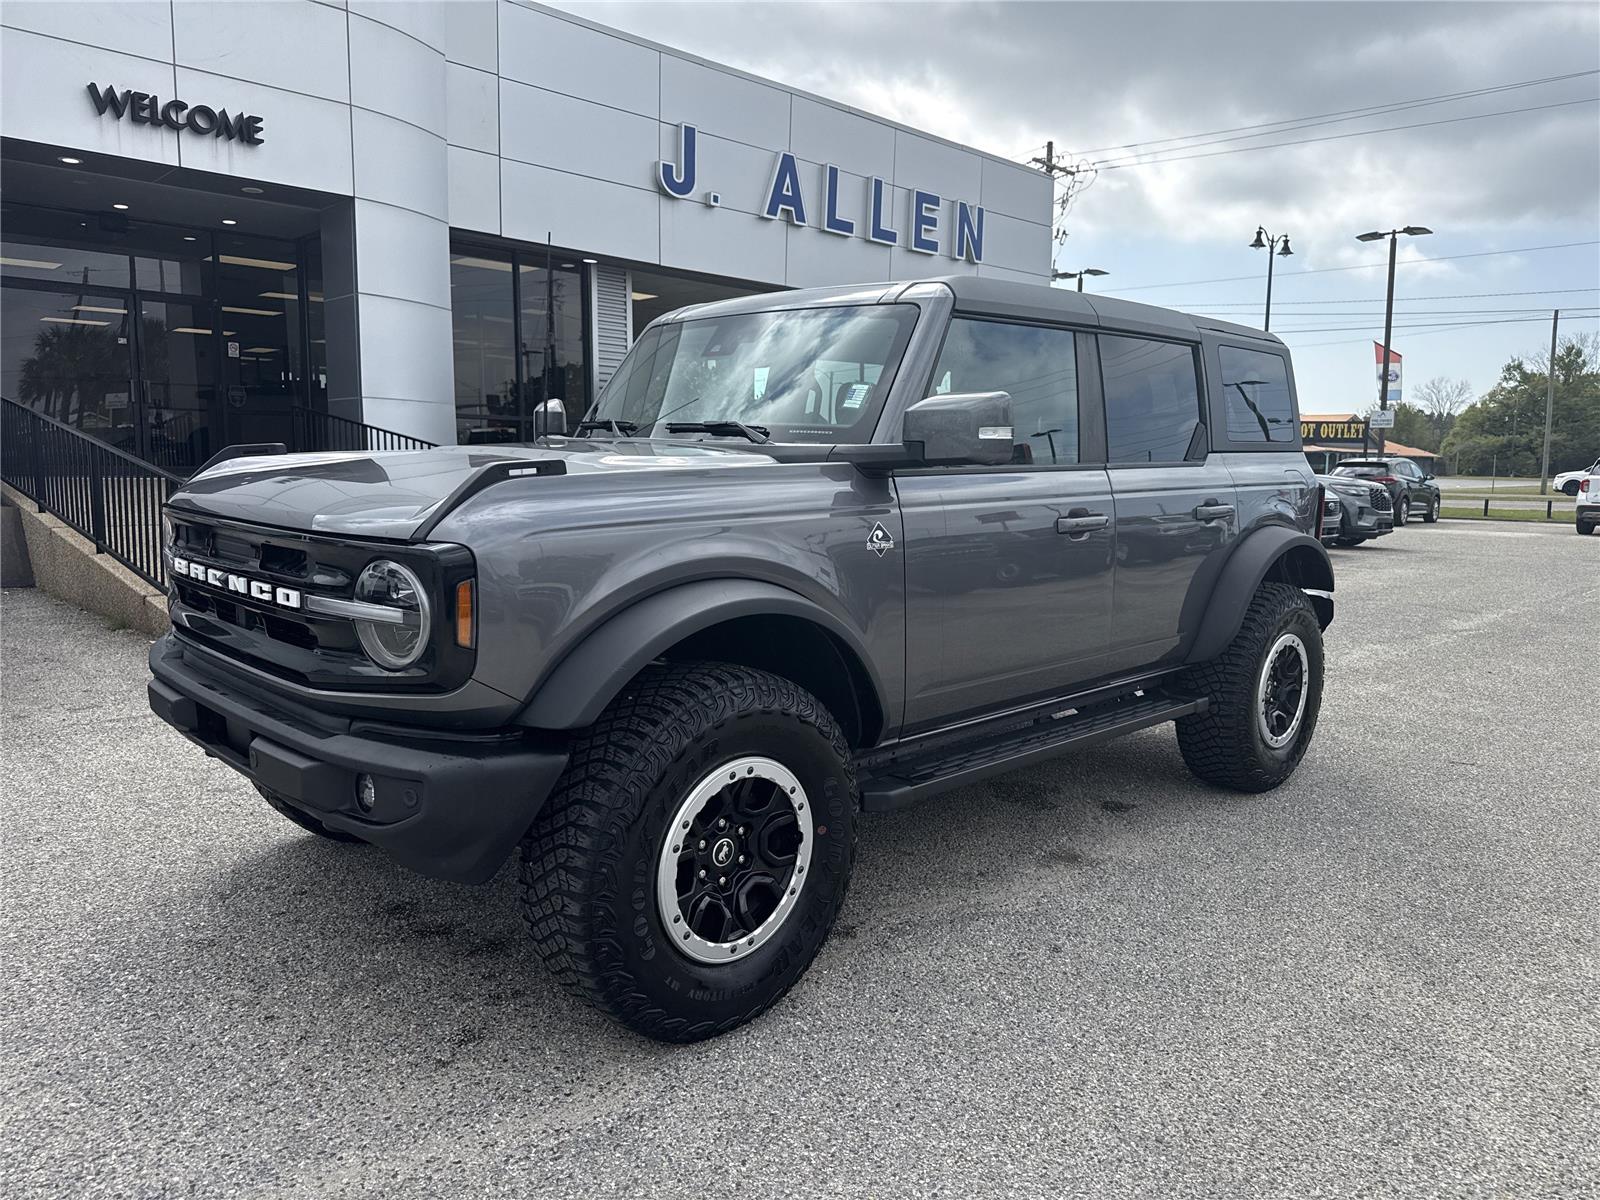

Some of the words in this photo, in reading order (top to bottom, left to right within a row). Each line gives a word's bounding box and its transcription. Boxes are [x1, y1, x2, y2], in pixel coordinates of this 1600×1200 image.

[87, 82, 265, 146] WELCOME
[656, 122, 721, 208] J.
[760, 150, 985, 264] ALLEN
[1320, 423, 1365, 438] OUTLET
[173, 557, 301, 608] BRONCO
